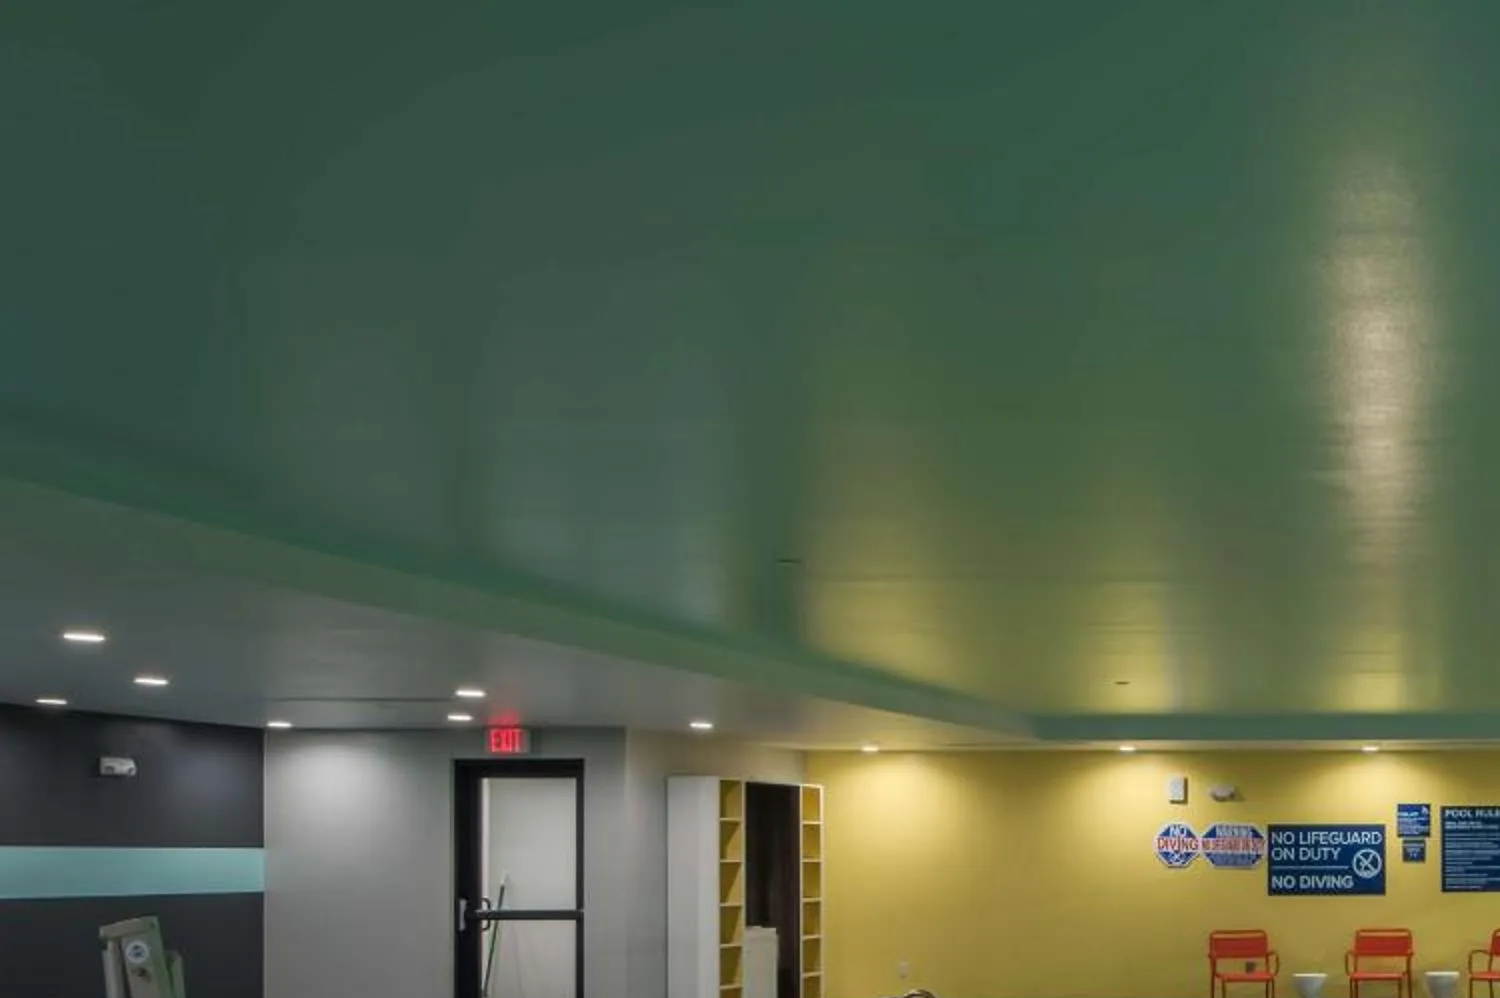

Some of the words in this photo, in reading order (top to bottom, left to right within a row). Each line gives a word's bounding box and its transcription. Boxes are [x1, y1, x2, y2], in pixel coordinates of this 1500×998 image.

[491, 729, 523, 752] EXIT
[1169, 826, 1187, 838] NO
[1271, 831, 1295, 845] NO
[1299, 831, 1383, 845] LIFEGUARD
[1157, 838, 1198, 850] DIVING
[1271, 847, 1295, 861] ON
[1299, 847, 1341, 861] DUTY
[1271, 875, 1296, 889] NO
[1299, 875, 1354, 889] DIVING
